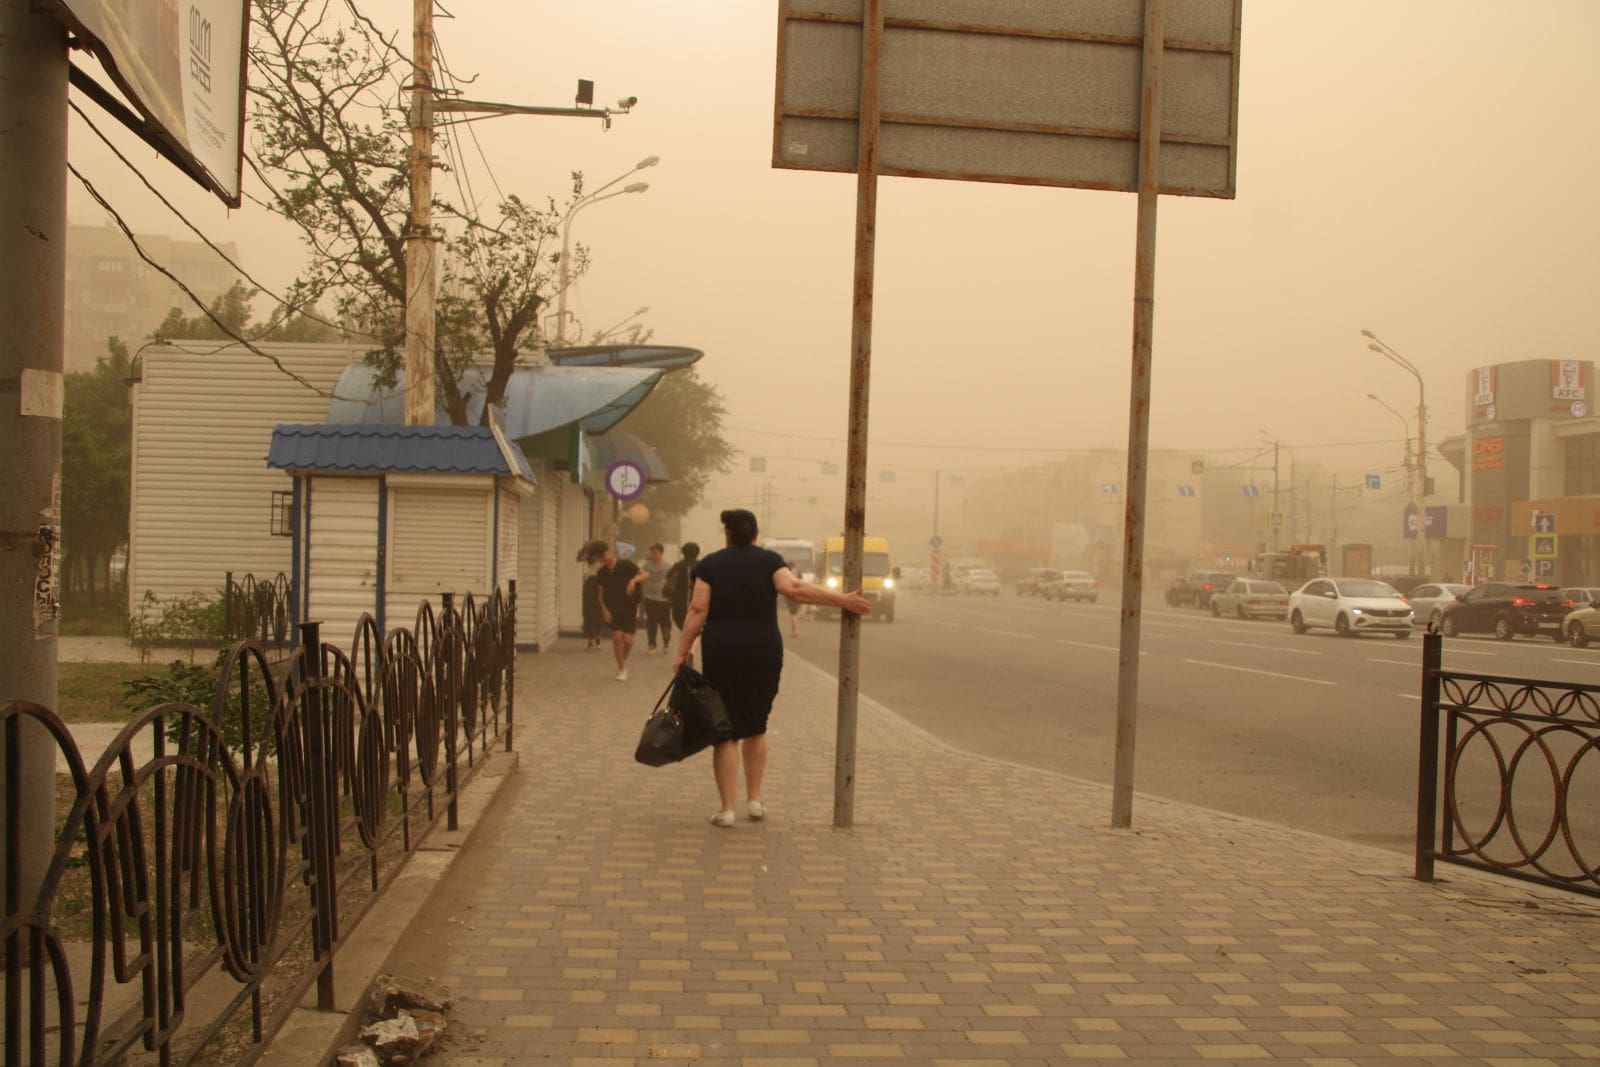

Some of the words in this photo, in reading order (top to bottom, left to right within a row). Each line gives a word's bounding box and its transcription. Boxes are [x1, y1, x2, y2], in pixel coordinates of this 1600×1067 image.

[1478, 394, 1491, 403] KFC
[1557, 389, 1580, 398] KFC
[1473, 438, 1503, 455] DNS
[1540, 561, 1551, 575] P
